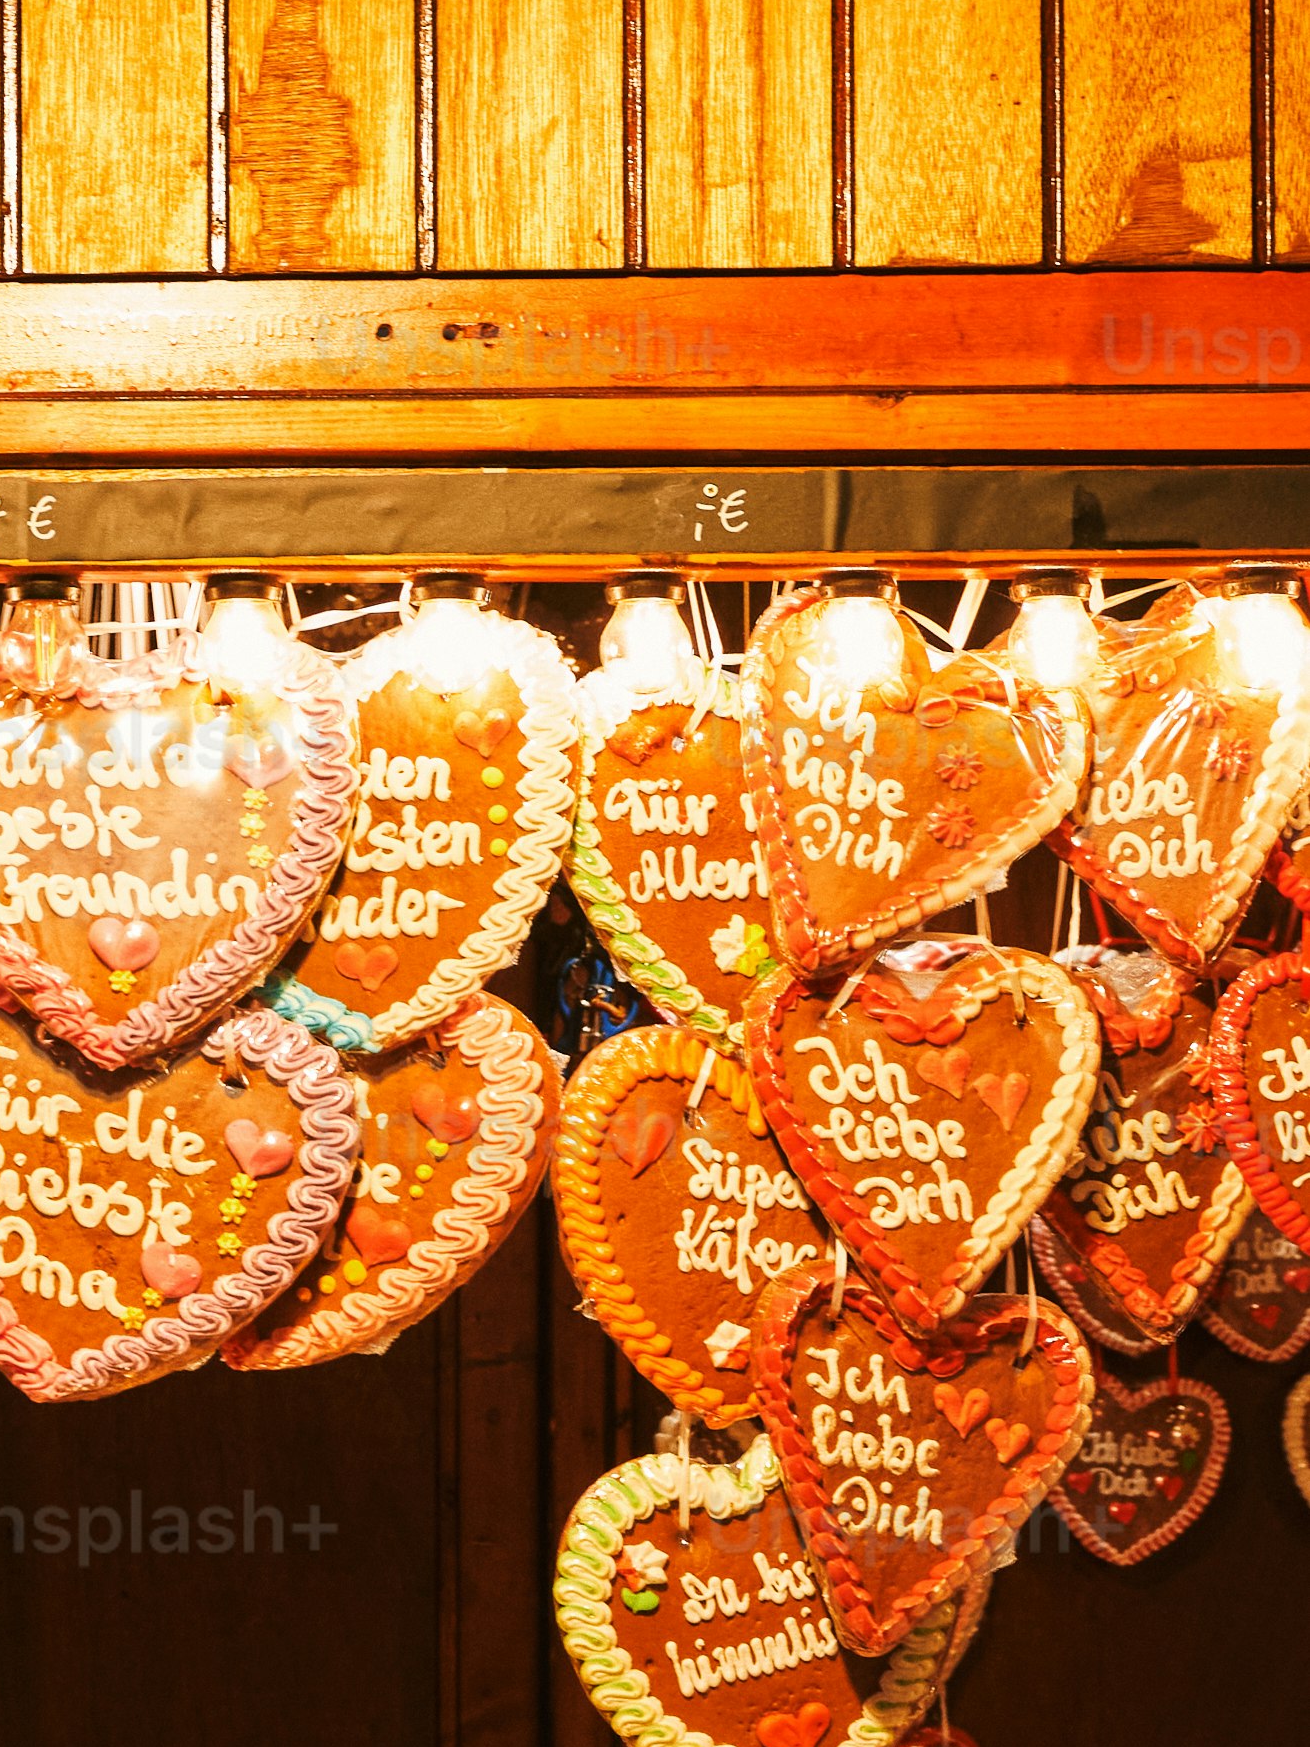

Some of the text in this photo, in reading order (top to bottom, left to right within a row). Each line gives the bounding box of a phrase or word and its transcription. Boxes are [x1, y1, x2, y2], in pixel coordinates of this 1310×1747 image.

[782, 727, 909, 819] liebe
[1090, 758, 1196, 826] iebe
[795, 803, 904, 882] Dich
[318, 875, 467, 943] uder
[94, 1089, 217, 1176] die
[811, 1102, 968, 1163] liebe
[805, 1345, 912, 1414] Ich
[811, 1404, 941, 1478] liebe
[832, 1475, 944, 1546] Dich
[752, 1551, 816, 1604] bis
[665, 1605, 840, 1699] himmlis
